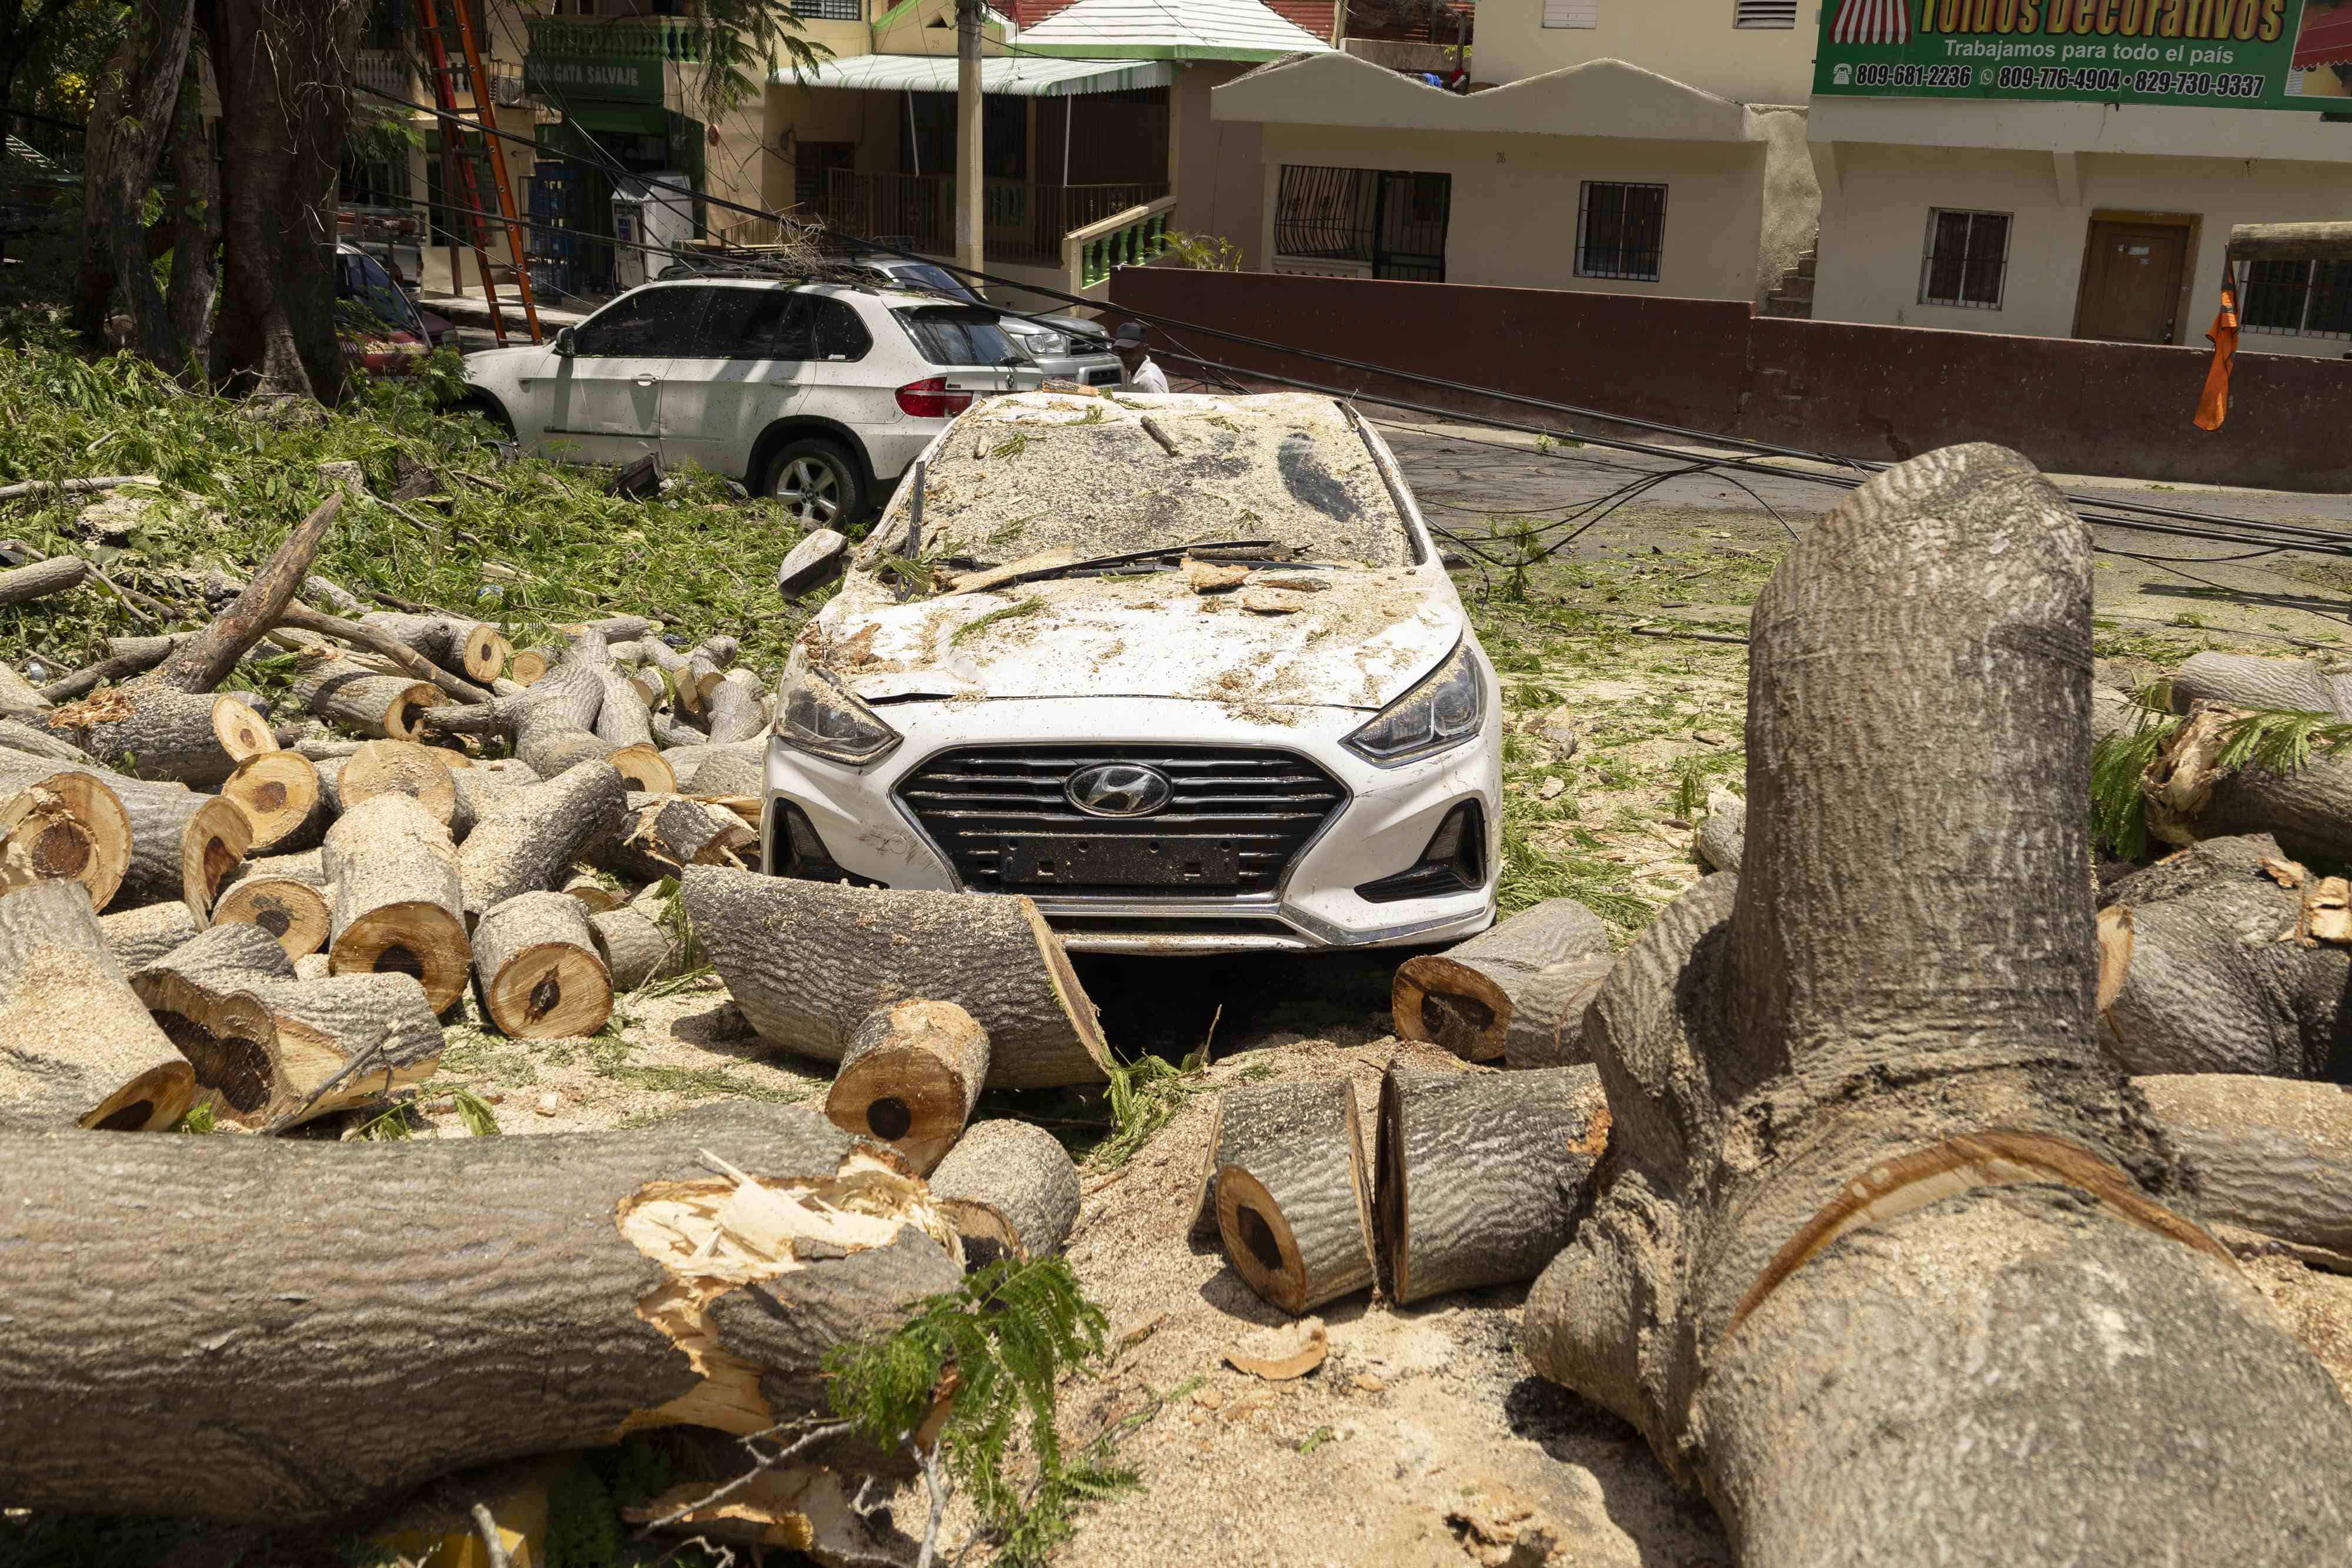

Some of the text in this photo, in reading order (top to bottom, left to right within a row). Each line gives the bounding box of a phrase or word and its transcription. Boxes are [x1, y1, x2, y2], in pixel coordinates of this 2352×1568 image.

[2044, 0, 2286, 43] Decorativos
[1945, 39, 2234, 66] Trabajamos para todo el país
[554, 63, 583, 83] GATA
[587, 65, 640, 87] SALVAJE
[1855, 63, 2265, 98] 809-681-2236 809-776-4904 829-730-9337
